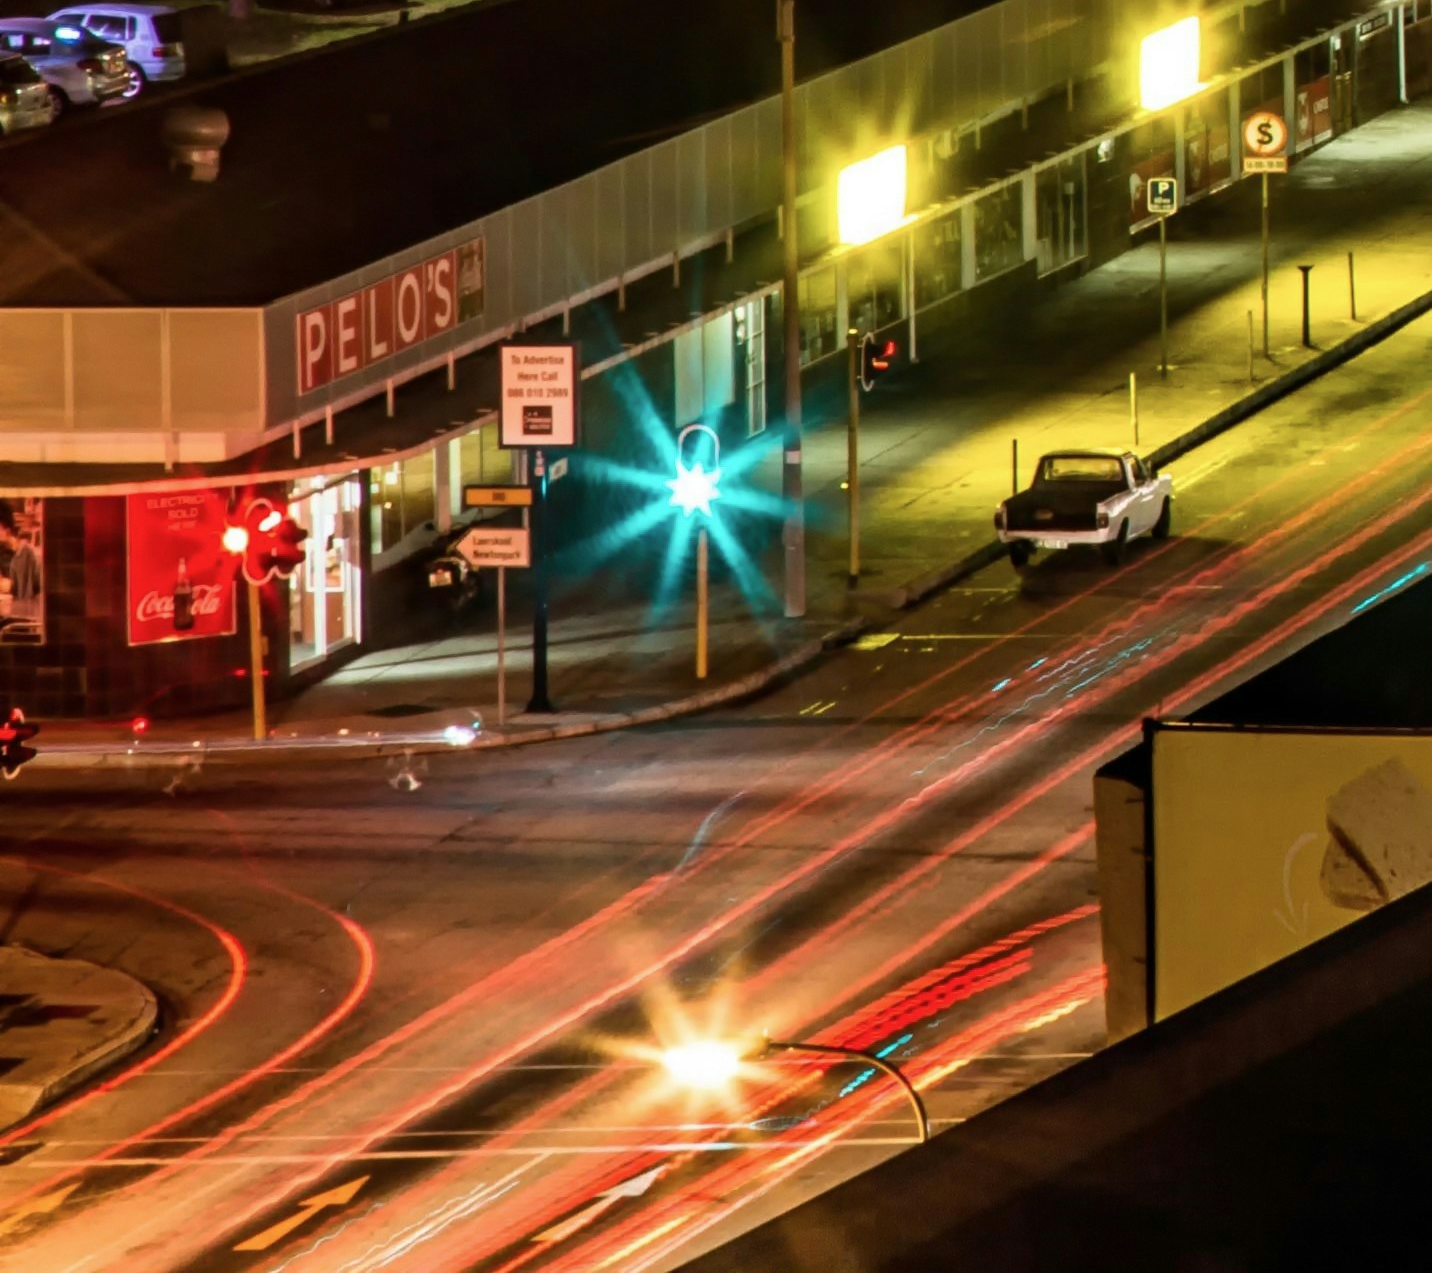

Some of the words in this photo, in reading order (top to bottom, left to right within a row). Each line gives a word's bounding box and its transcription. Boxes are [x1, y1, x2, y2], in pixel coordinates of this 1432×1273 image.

[1158, 182, 1170, 195] P
[305, 258, 452, 389] PELO'S
[523, 355, 565, 365] Advertise
[517, 372, 539, 381] Here
[541, 372, 558, 382] Call
